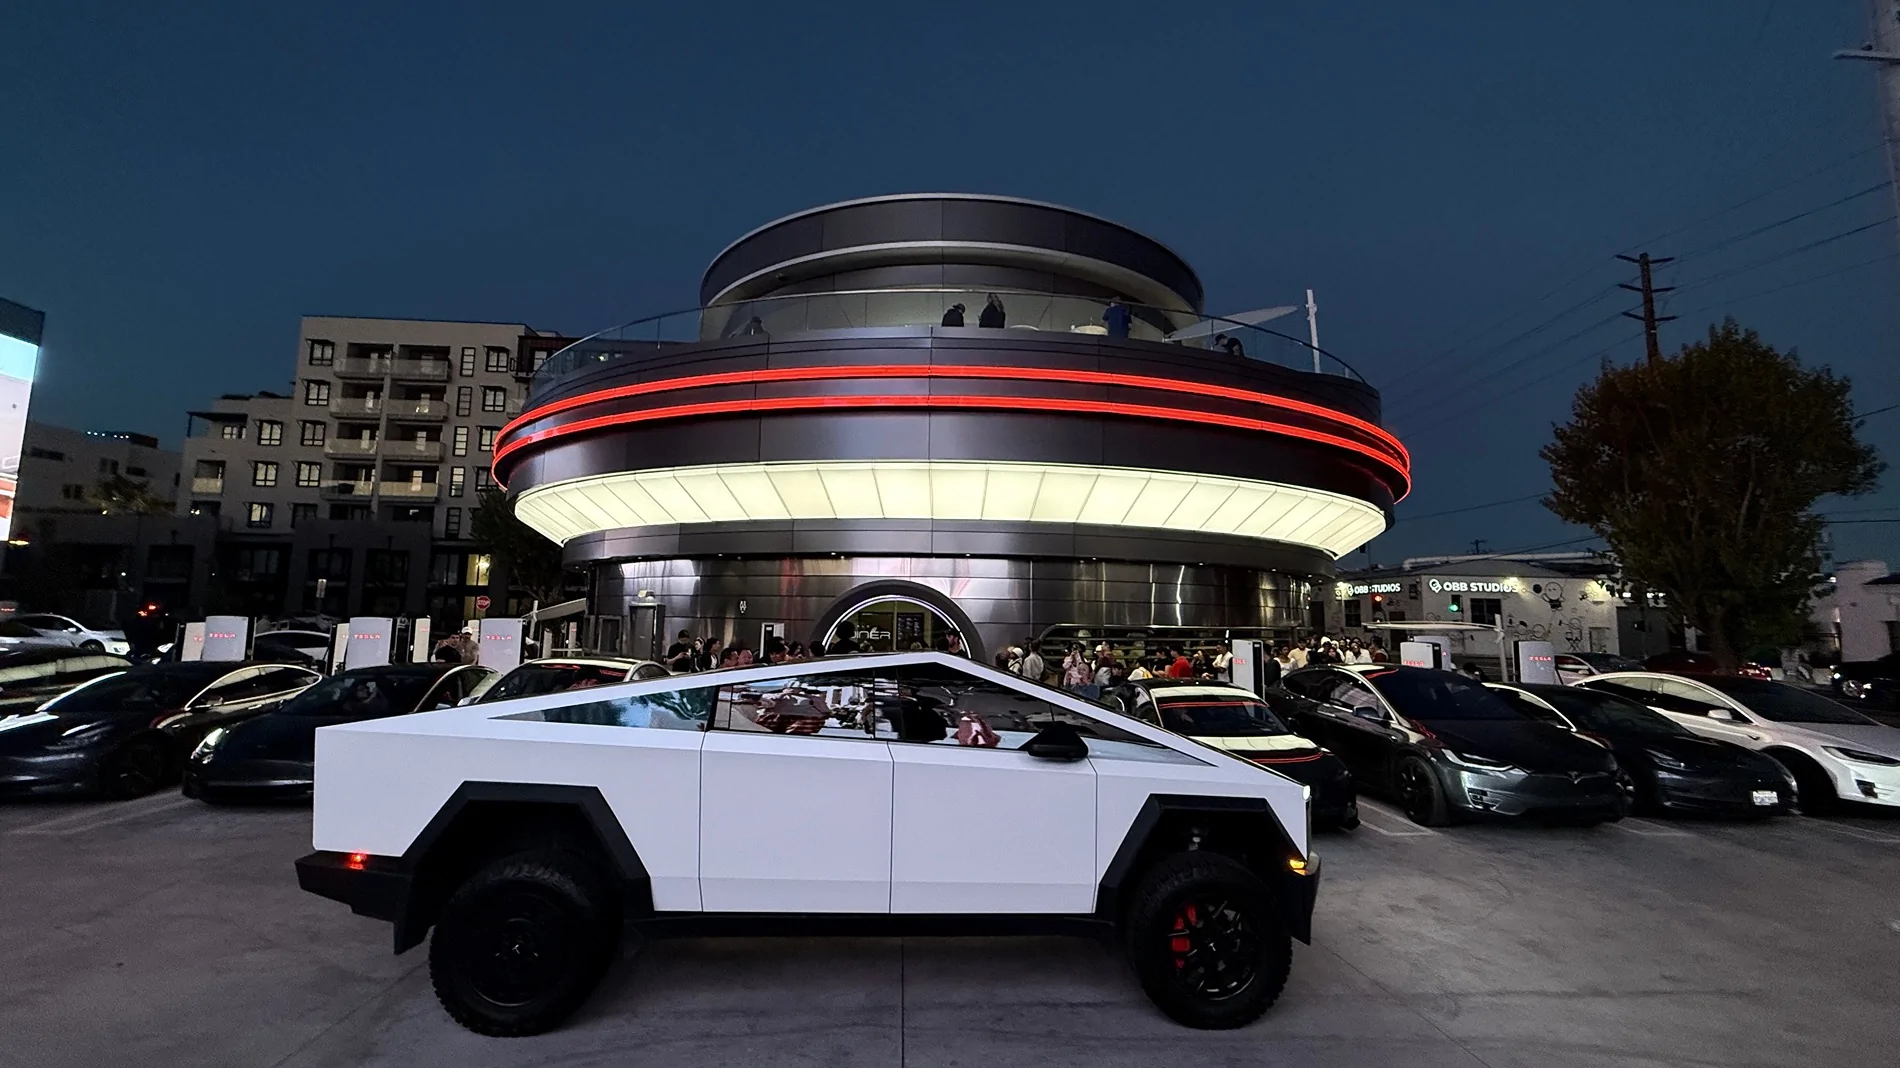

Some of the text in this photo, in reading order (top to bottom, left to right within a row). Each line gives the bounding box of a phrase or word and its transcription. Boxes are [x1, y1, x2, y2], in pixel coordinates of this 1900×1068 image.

[1354, 585, 1368, 594] OBB
[1443, 581, 1518, 592] OBB STUDIOS
